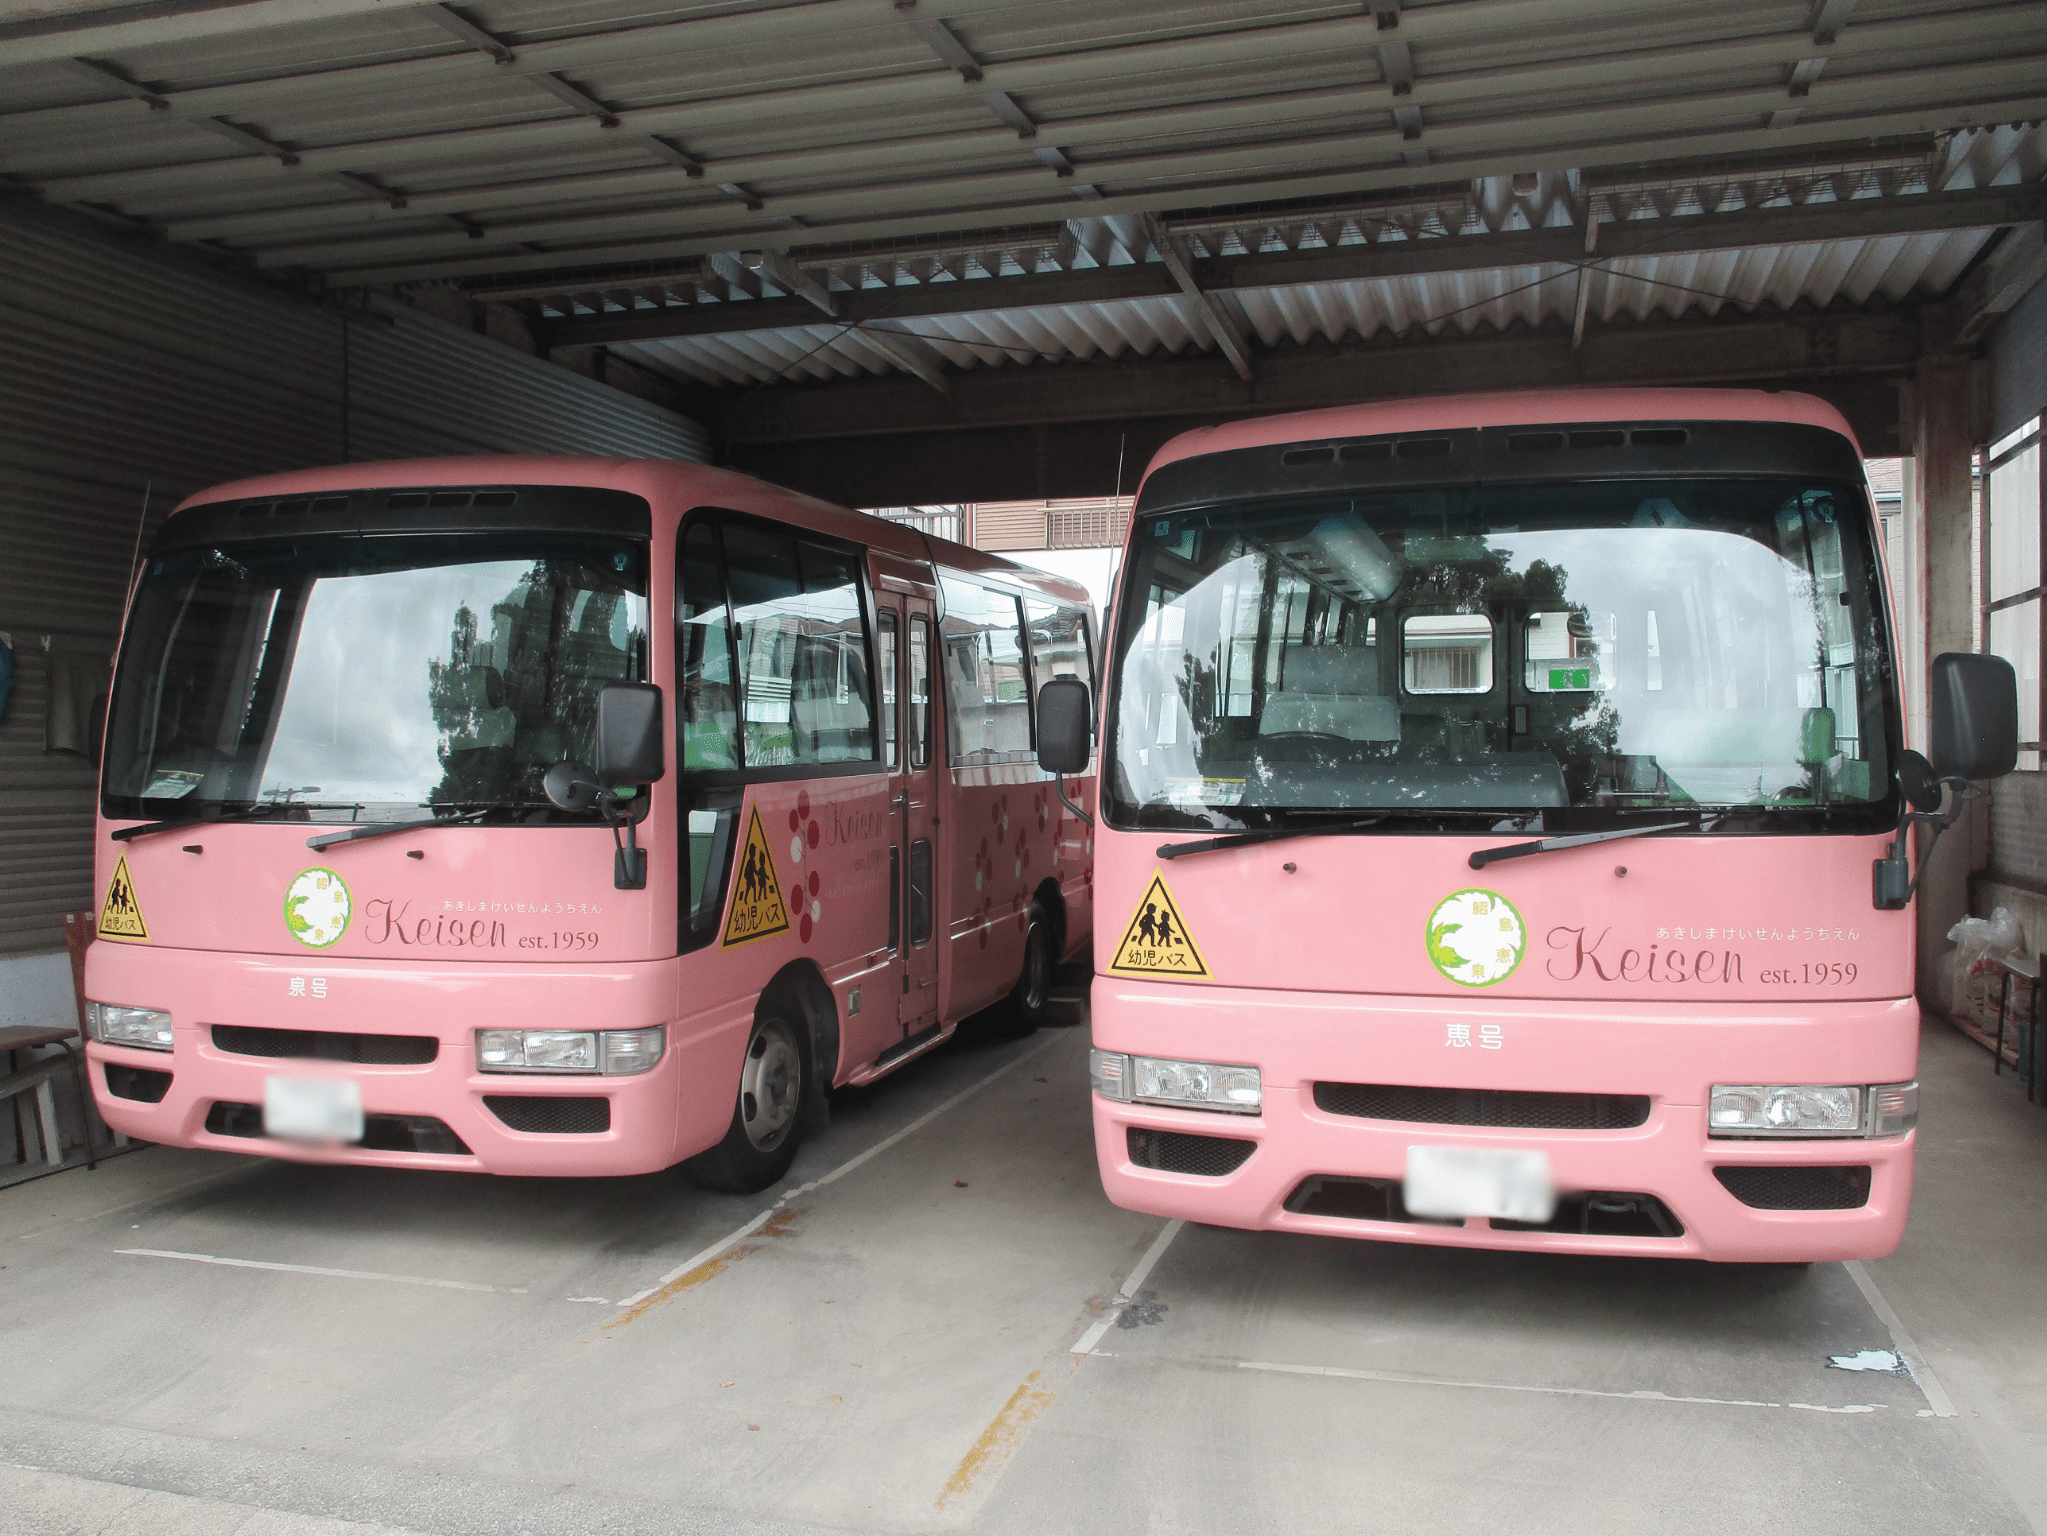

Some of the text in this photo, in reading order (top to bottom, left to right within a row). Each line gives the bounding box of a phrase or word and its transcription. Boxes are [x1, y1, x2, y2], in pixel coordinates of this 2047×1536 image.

[442, 900, 603, 915] あきしまけいせんようちえん
[733, 902, 781, 934] 幼児バス
[105, 916, 136, 931] 幼児バス
[364, 898, 600, 951] Keisen est.1959
[1656, 926, 1860, 942] あきしまけいせんようちえん
[1127, 949, 1187, 967] 幼児バス
[1546, 926, 1858, 986] Keisen est.1959
[288, 976, 328, 999] 泉号
[1445, 1022, 1504, 1049] 恵号
